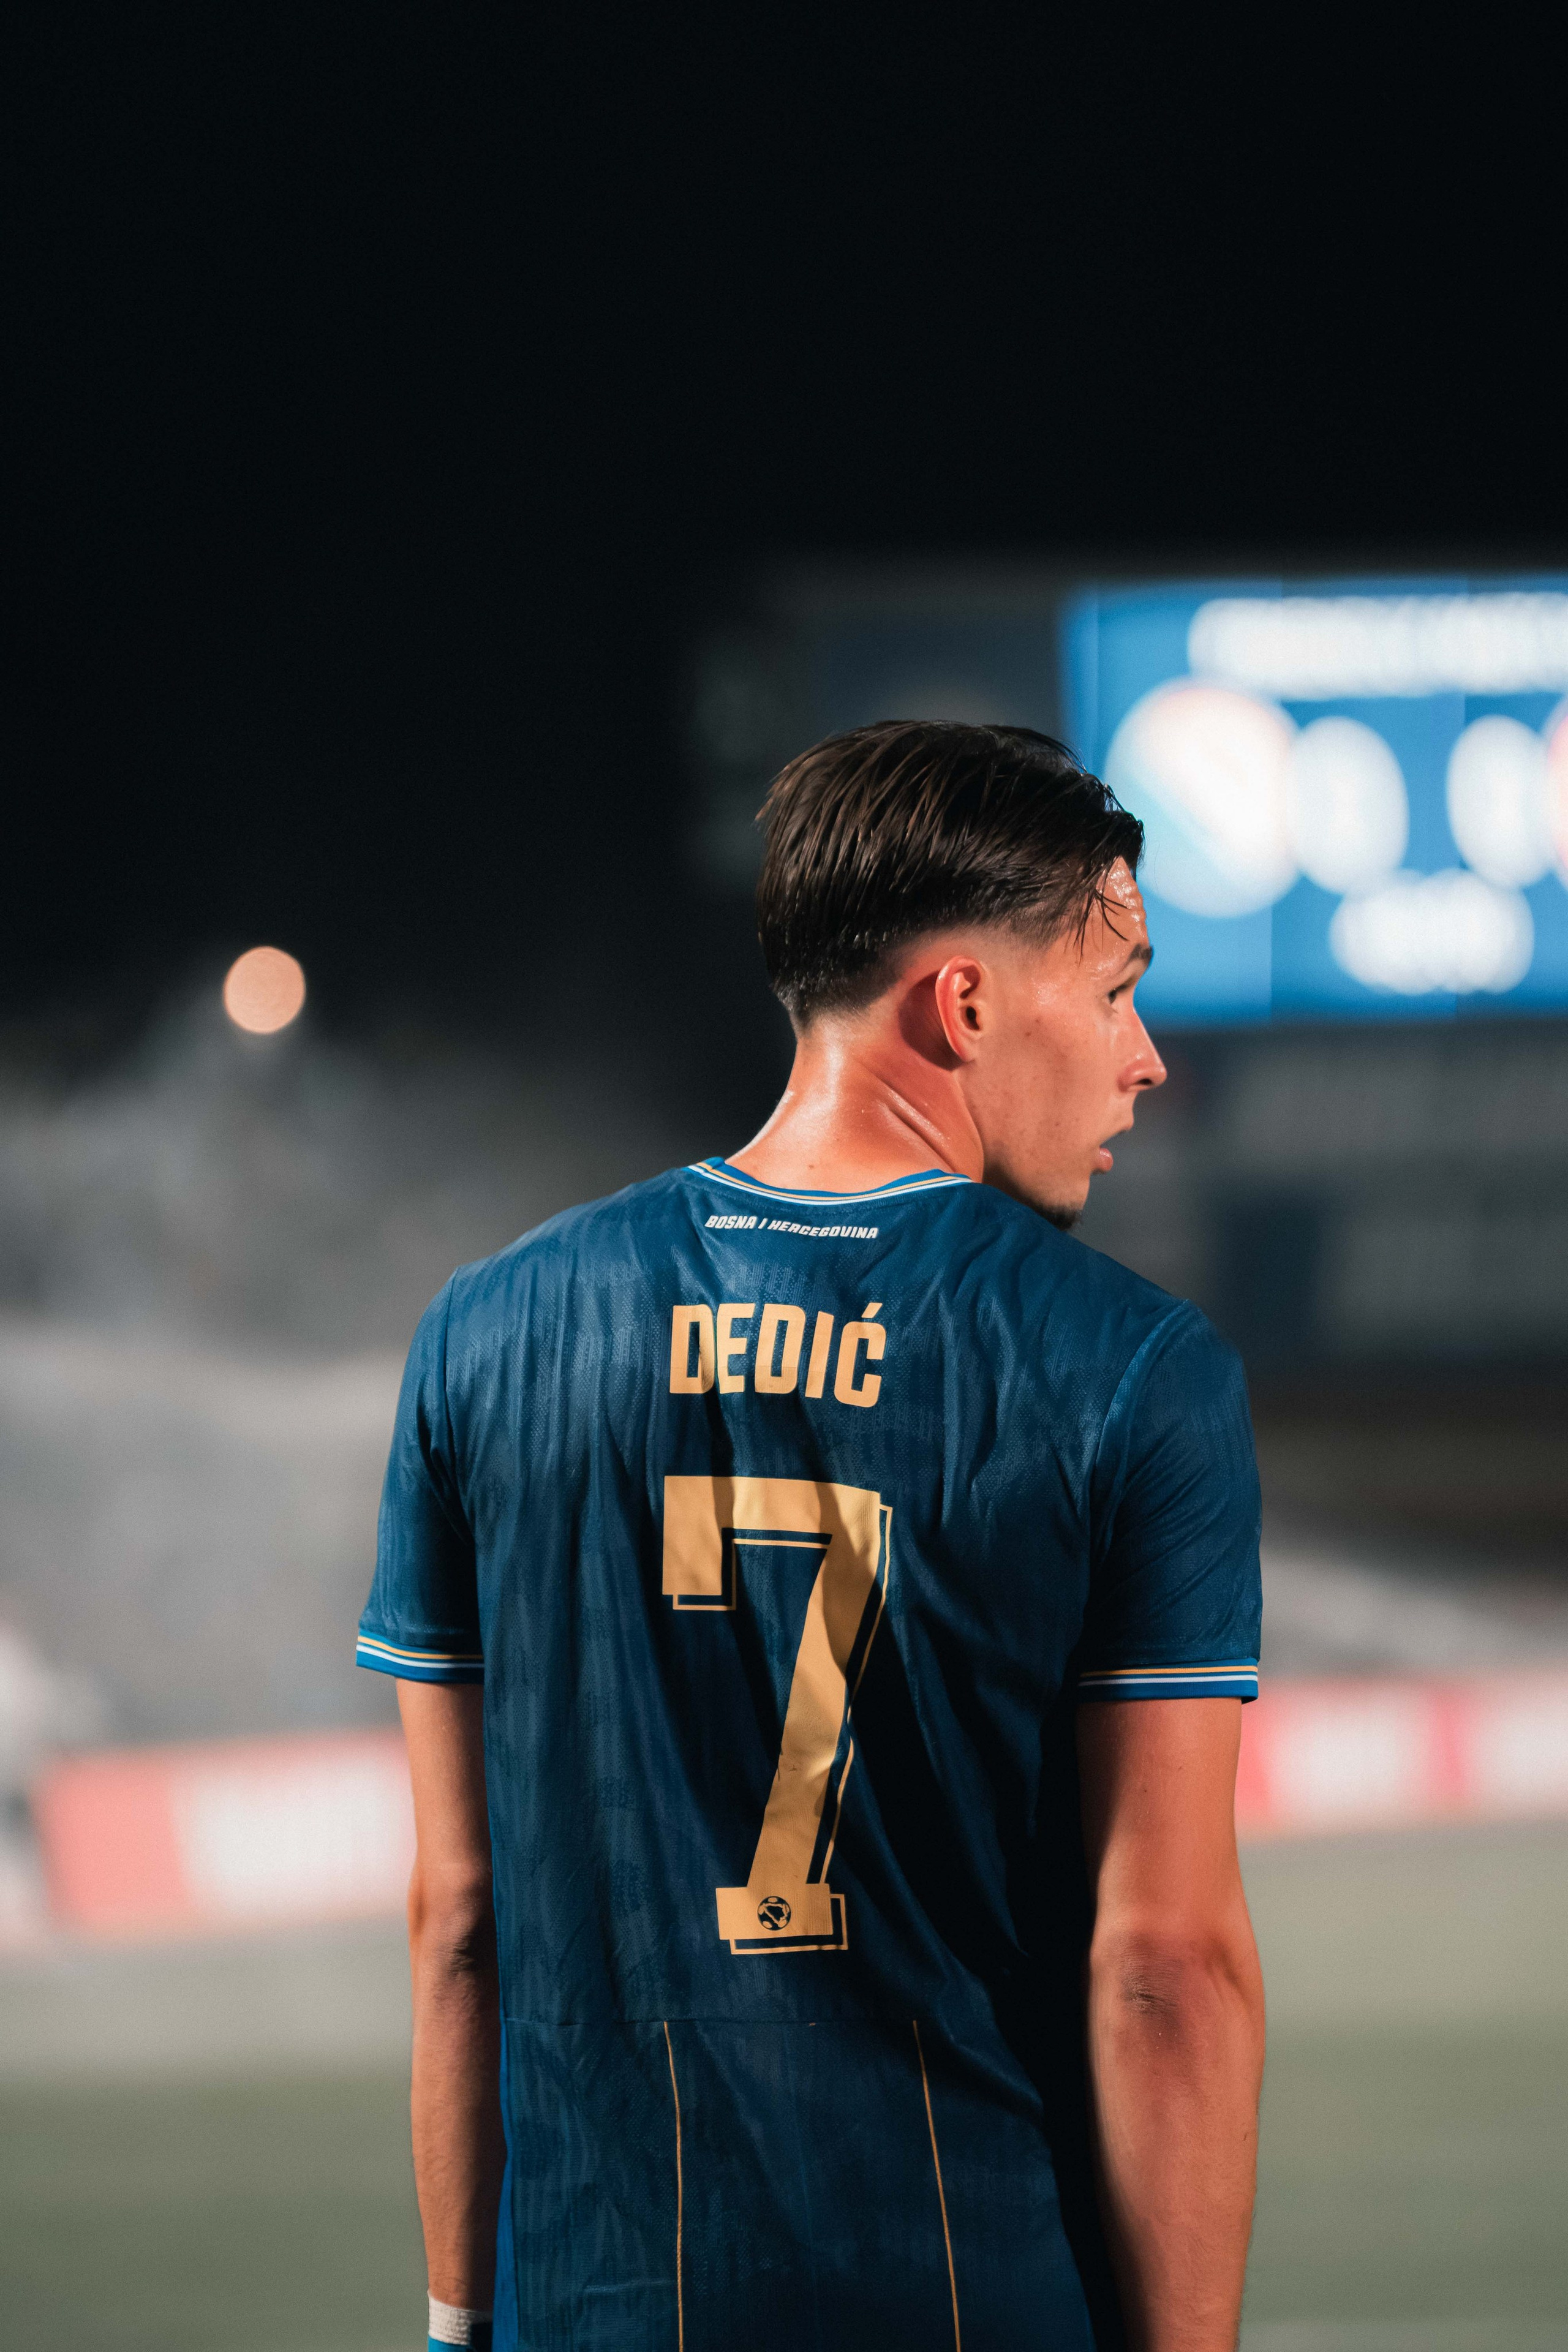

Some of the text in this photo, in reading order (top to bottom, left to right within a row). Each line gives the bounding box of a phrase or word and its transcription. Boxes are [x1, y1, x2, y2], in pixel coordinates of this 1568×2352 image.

[704, 1215, 878, 1238] BOSNA I HERCEGOVINA
[669, 1302, 886, 1408] DEDIĆ
[662, 1475, 892, 1955] 7
